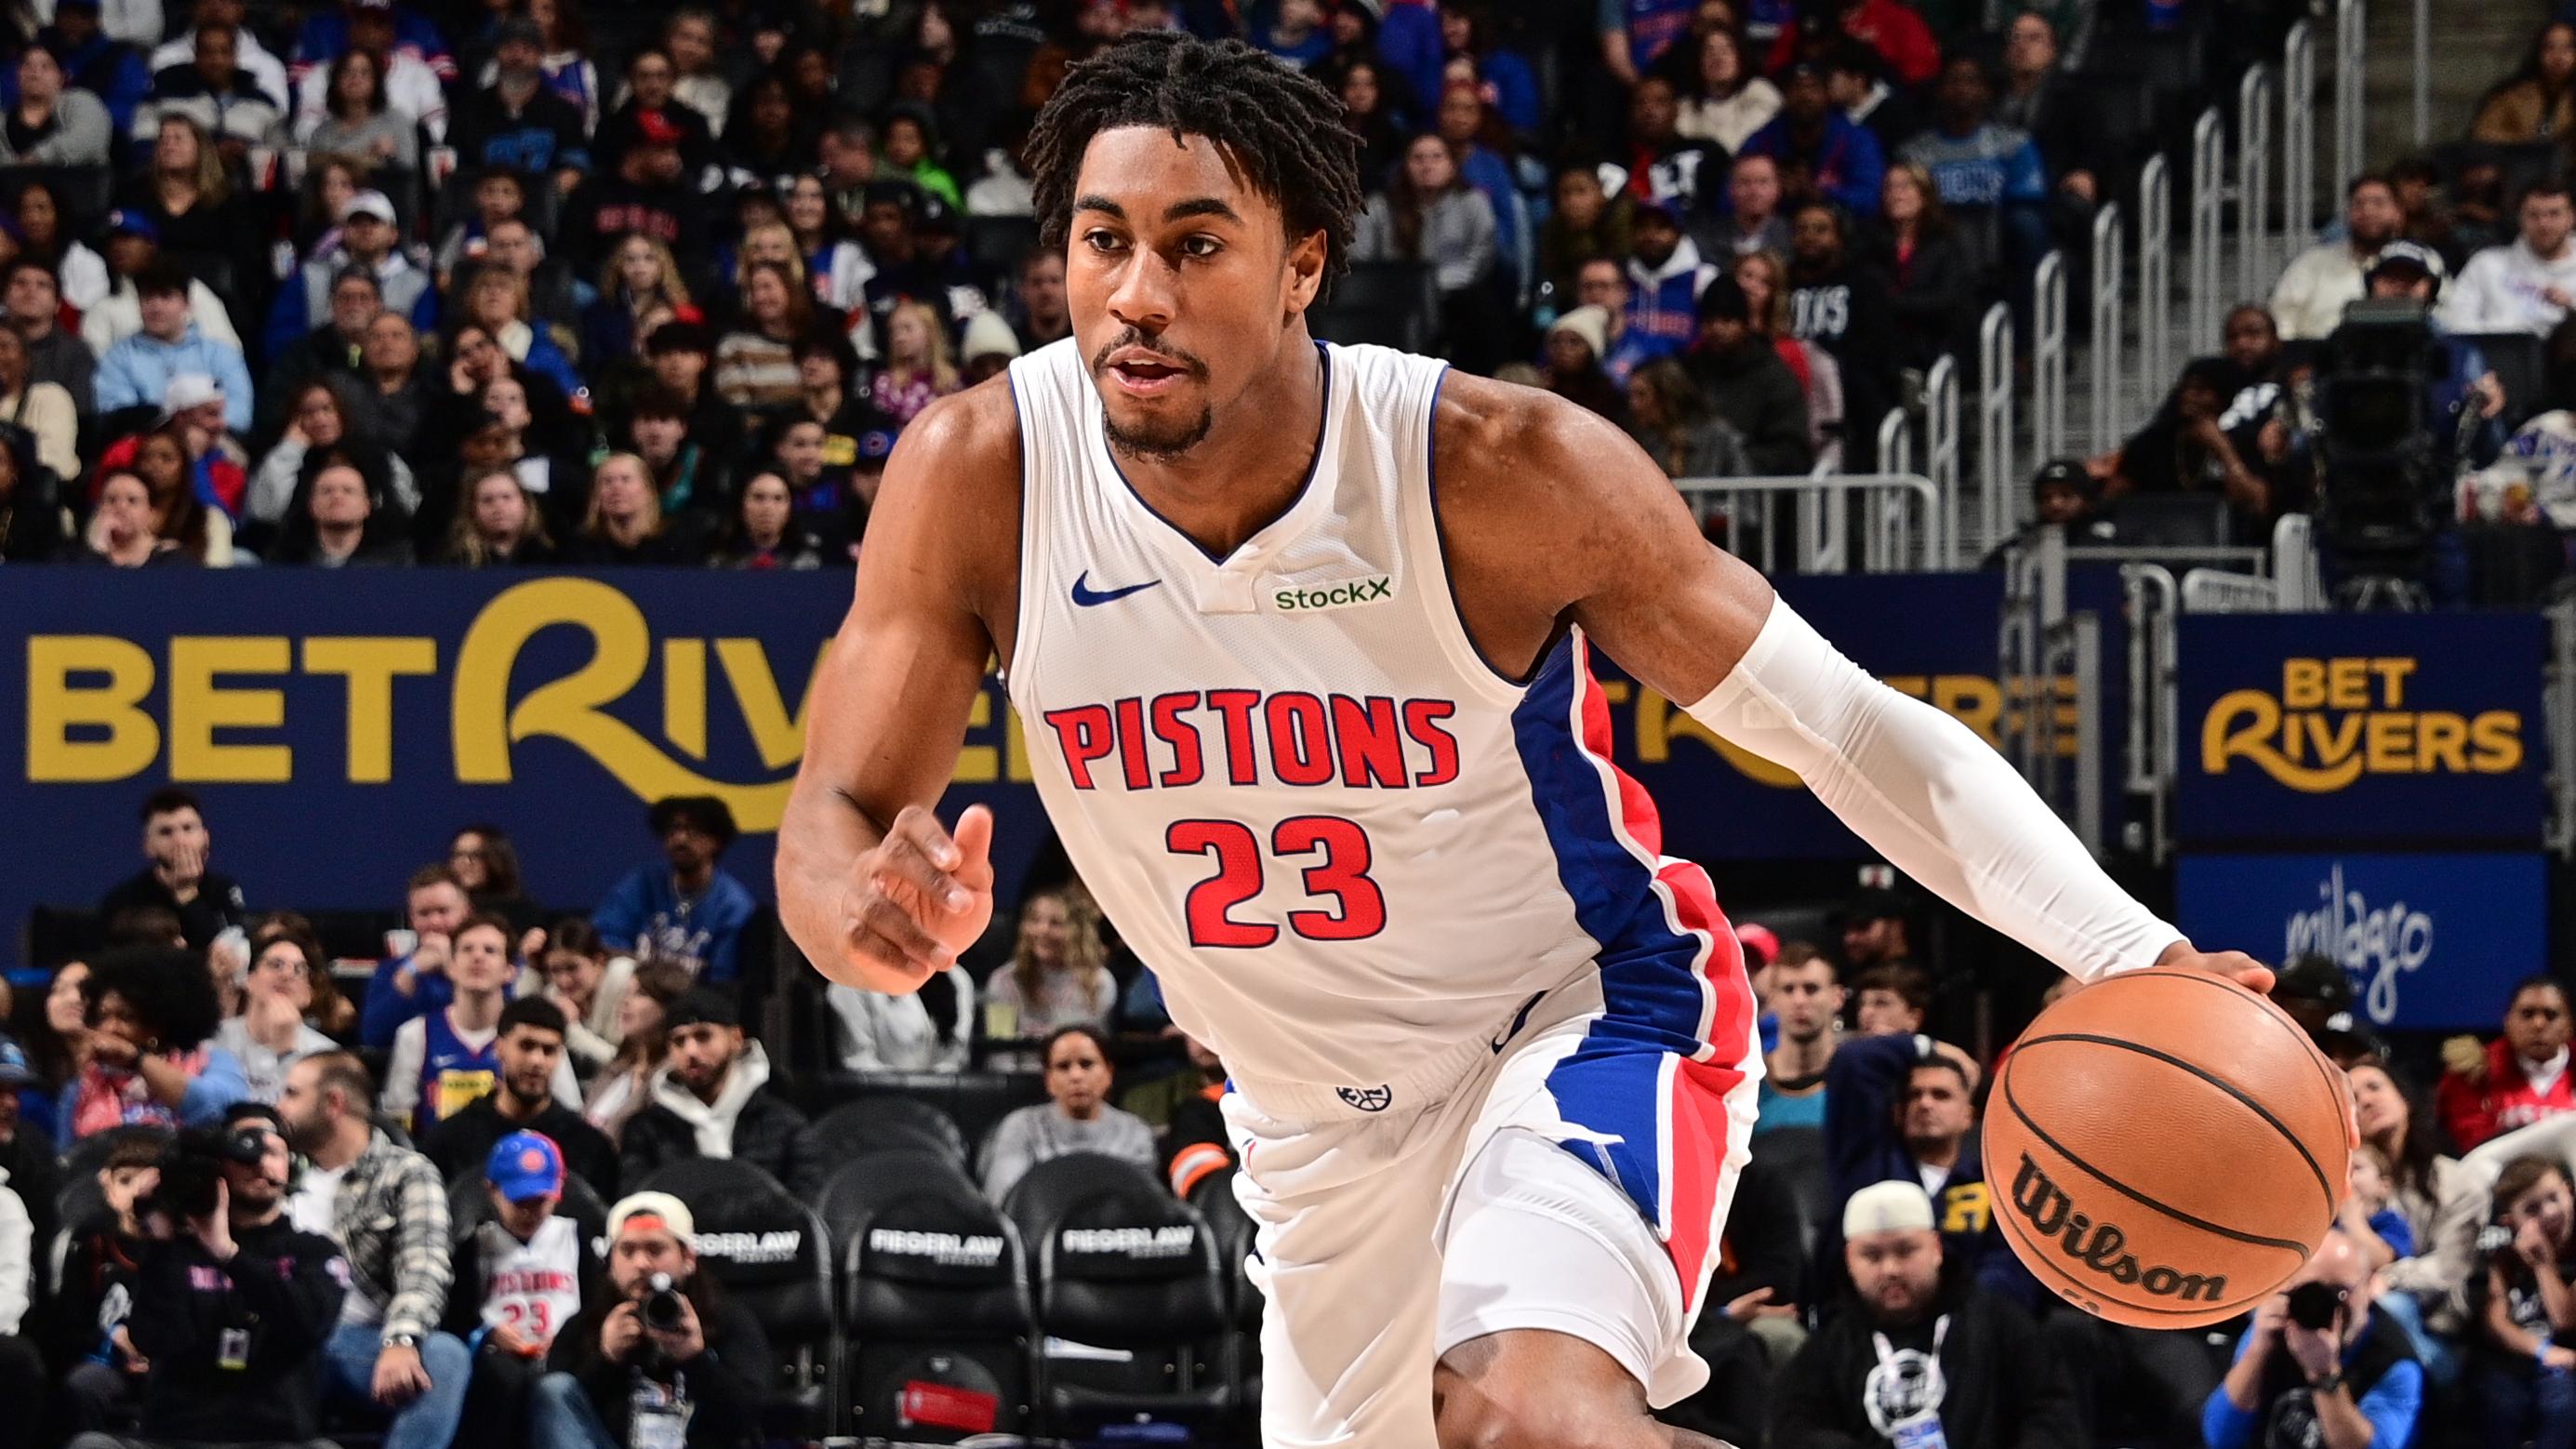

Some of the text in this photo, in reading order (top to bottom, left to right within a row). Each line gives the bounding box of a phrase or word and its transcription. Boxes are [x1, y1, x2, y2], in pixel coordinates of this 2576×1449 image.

[26, 635, 437, 784] BET
[1043, 688, 1461, 791] PISTONS
[2201, 689, 2524, 794] RIVERS
[2283, 658, 2418, 709] BET
[1164, 815, 1388, 950] 23
[2012, 1149, 2229, 1302] Wilson
